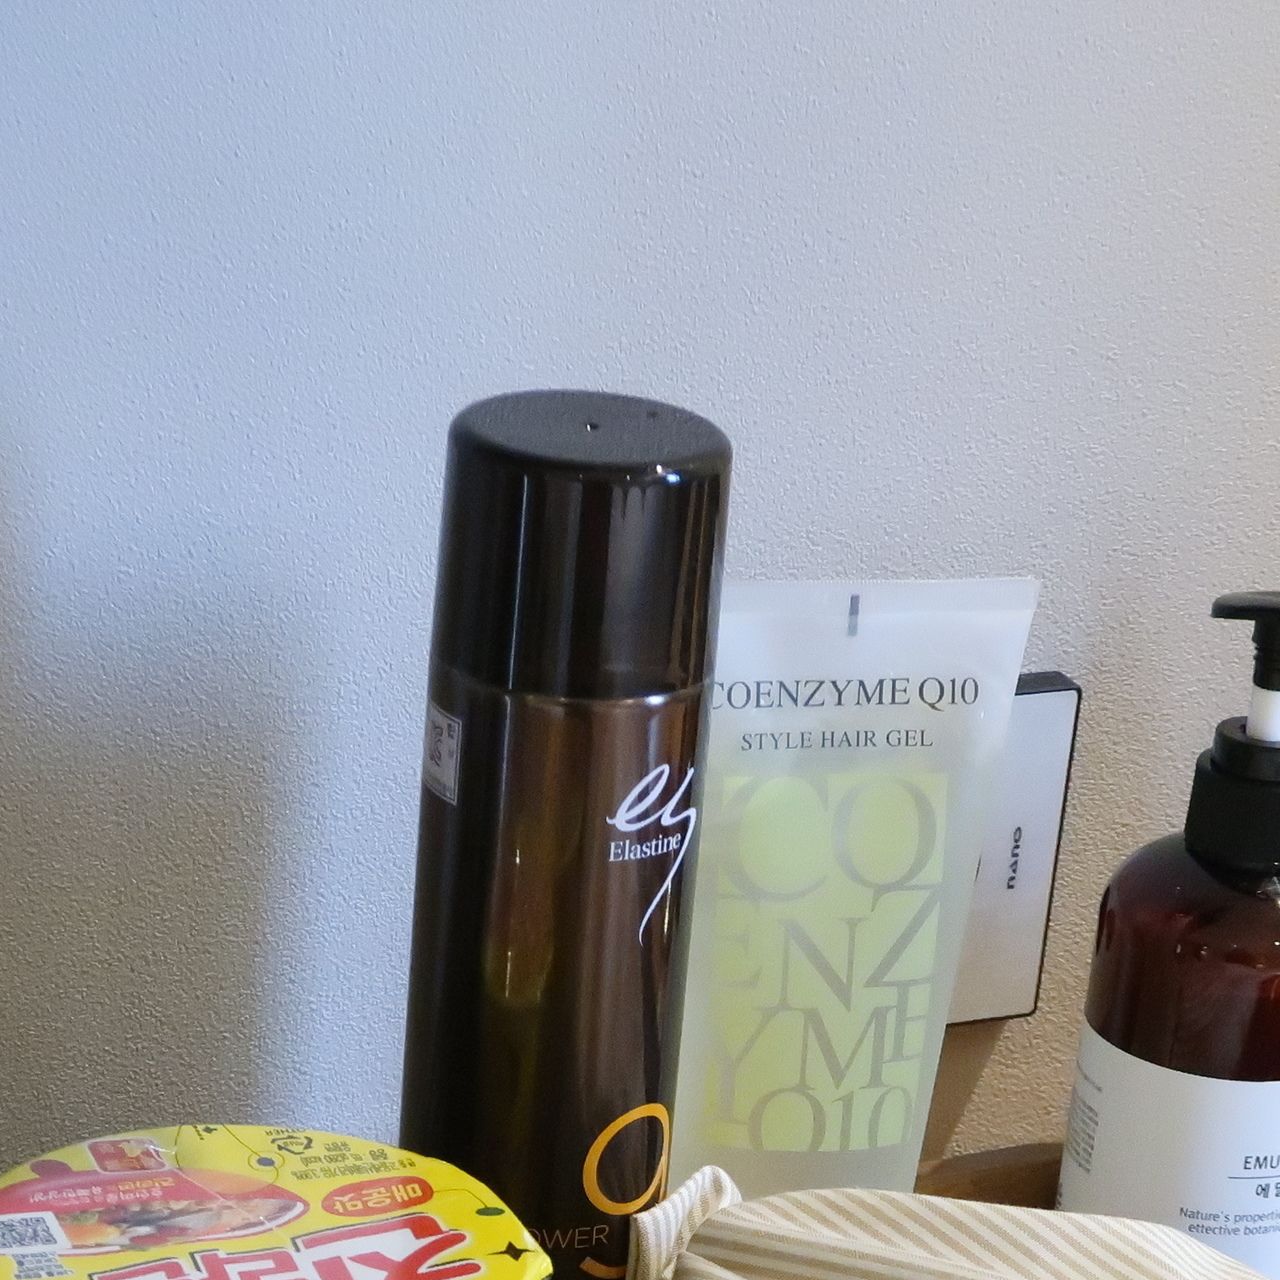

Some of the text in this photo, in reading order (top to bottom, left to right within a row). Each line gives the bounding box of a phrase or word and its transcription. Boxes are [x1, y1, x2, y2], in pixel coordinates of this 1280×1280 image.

[918, 676, 980, 712] Q10
[740, 729, 934, 752] STYLE HAIR GEL
[608, 832, 683, 862] Elastine
[332, 1182, 423, 1214] 매운맛
[1178, 1206, 1231, 1223] Nature's
